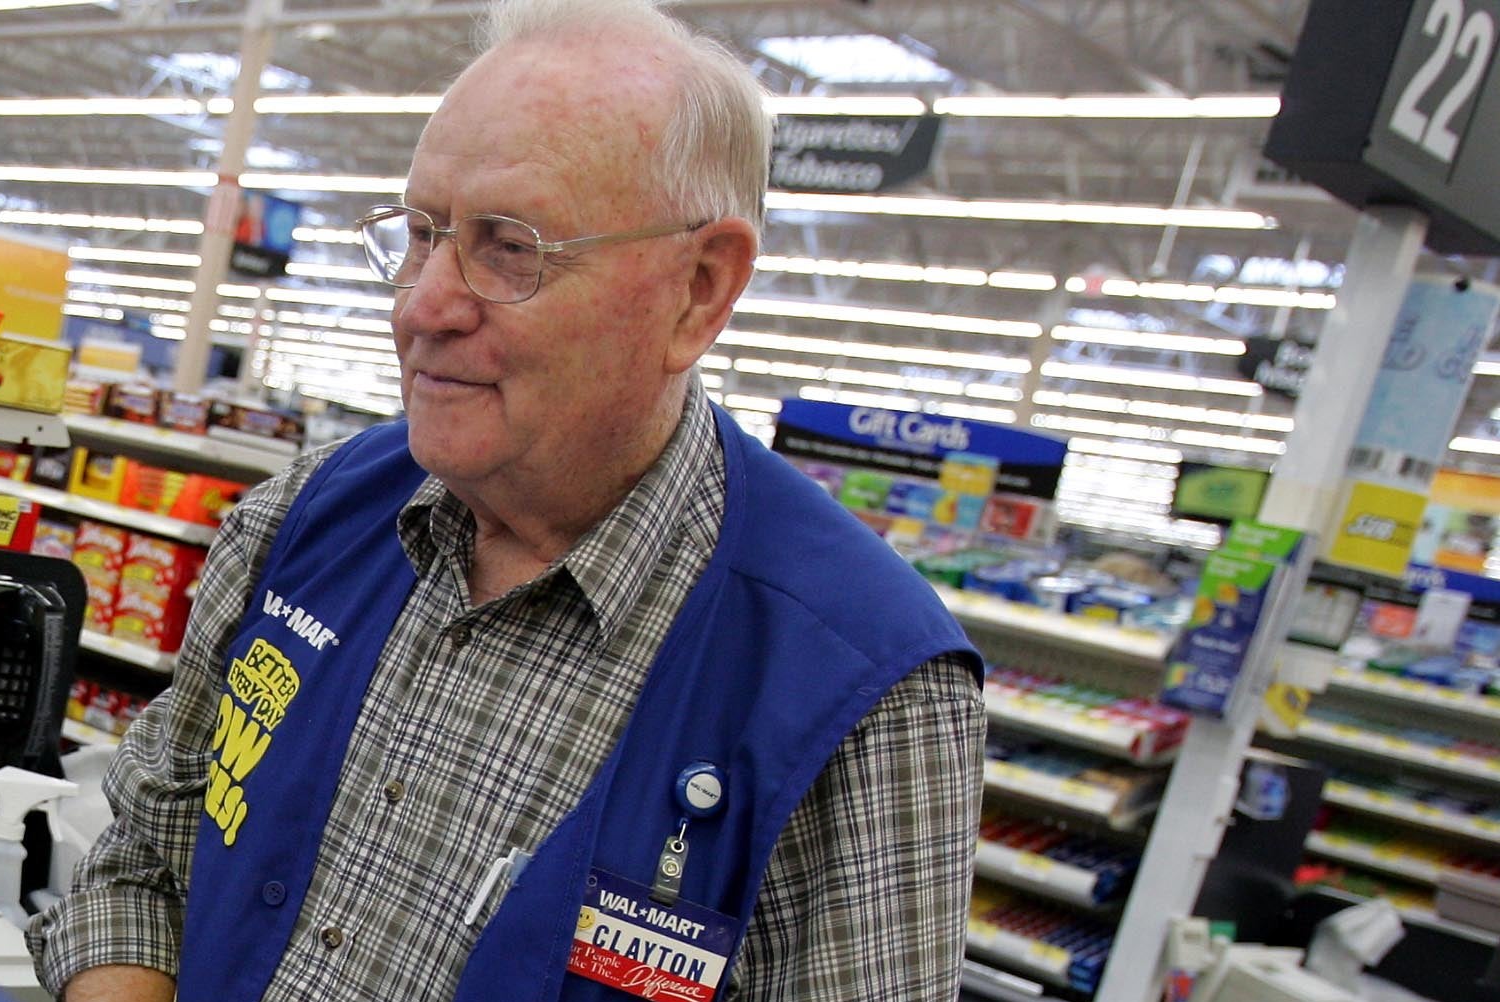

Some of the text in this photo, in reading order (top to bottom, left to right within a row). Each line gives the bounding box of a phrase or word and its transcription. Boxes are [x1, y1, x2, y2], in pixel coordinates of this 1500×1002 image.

[1389, 0, 1494, 164] 22
[849, 405, 971, 450] Gift Cards
[230, 663, 263, 700] EVERY
[246, 644, 297, 703] BETTER
[257, 699, 282, 727] DAY
[585, 946, 621, 969] People
[592, 924, 707, 983] CLAYTON
[621, 964, 706, 999] Difference
